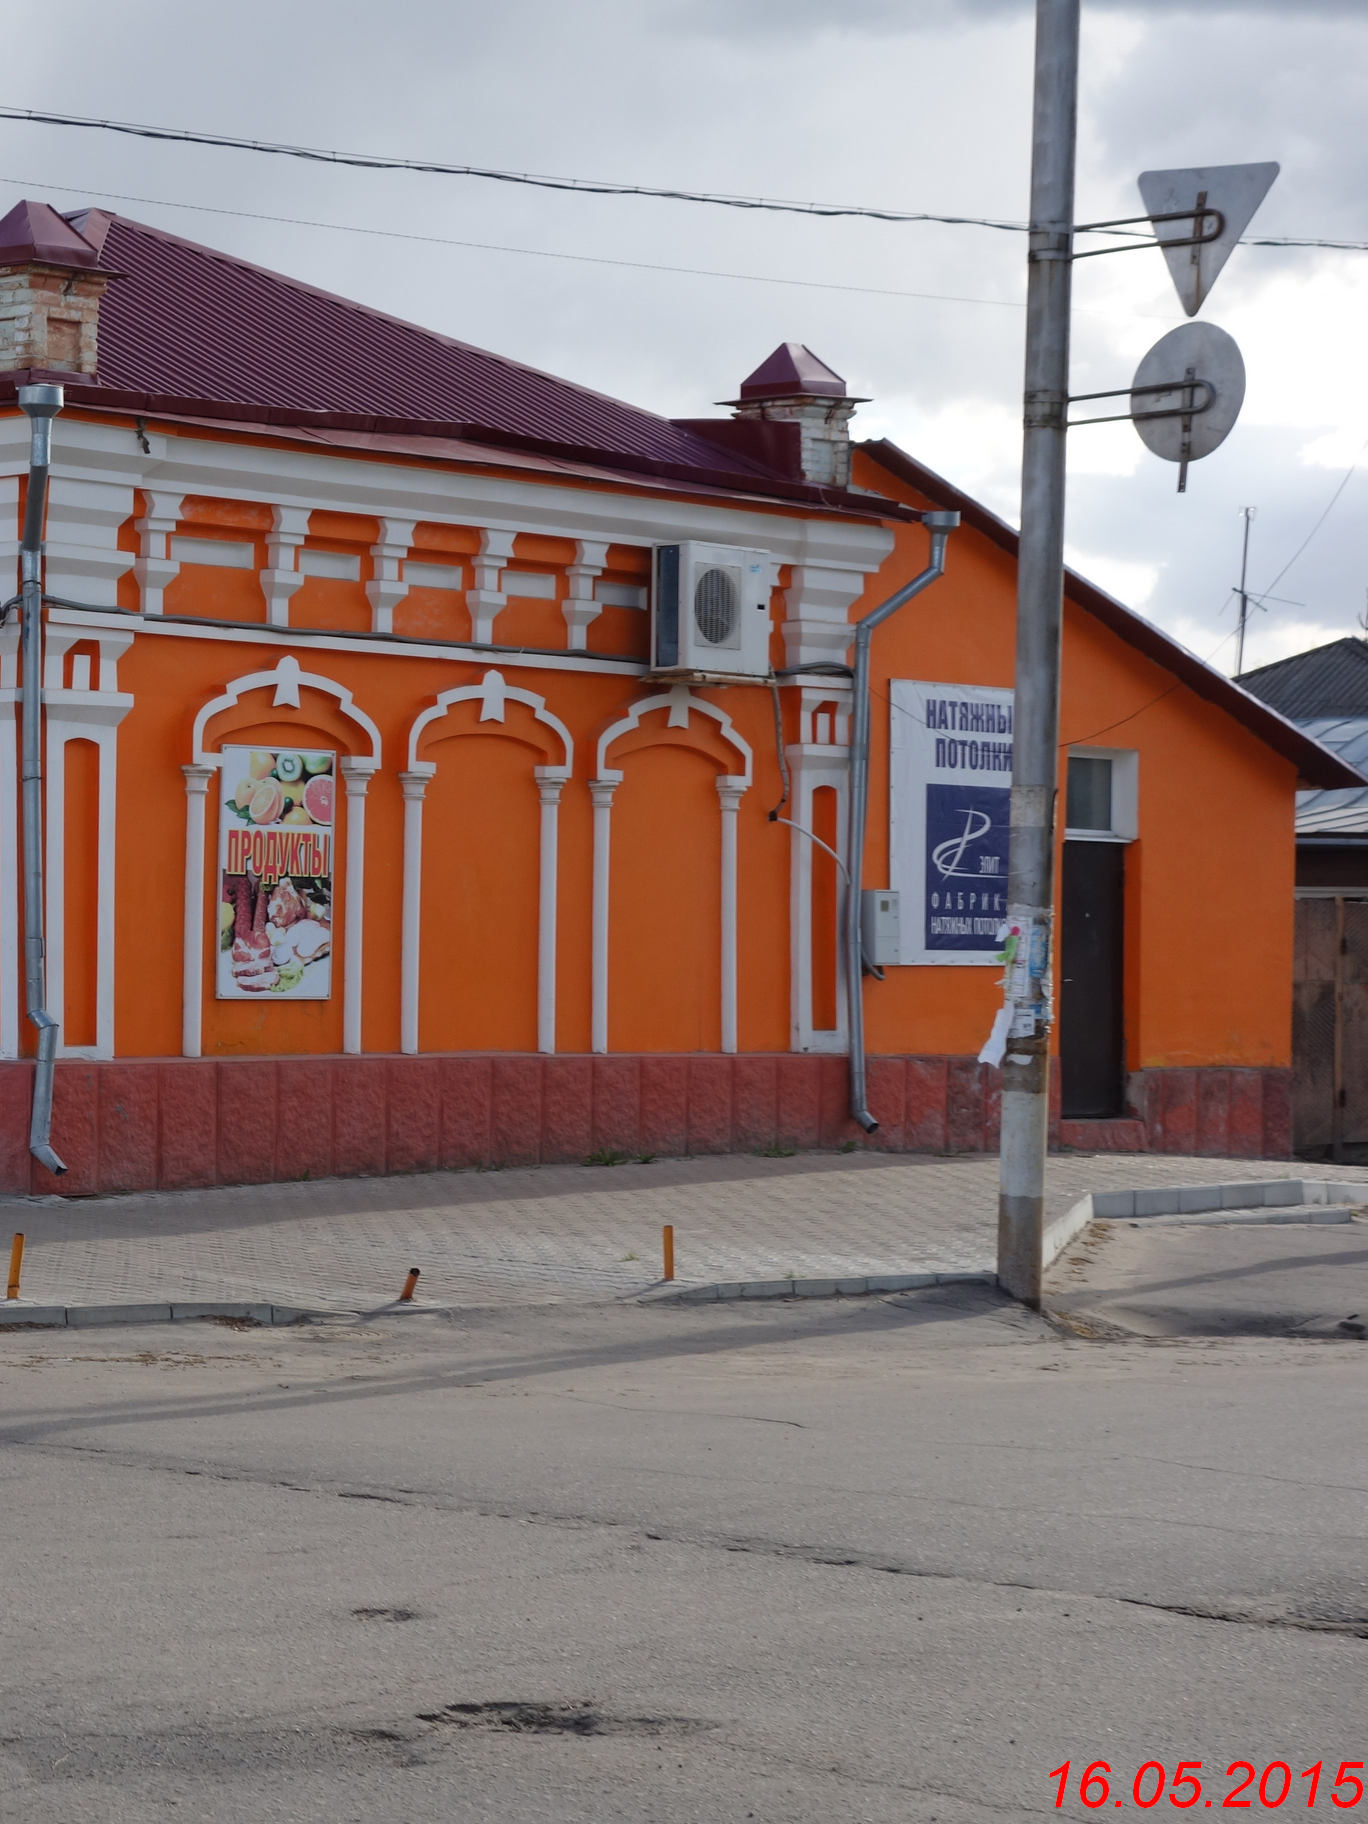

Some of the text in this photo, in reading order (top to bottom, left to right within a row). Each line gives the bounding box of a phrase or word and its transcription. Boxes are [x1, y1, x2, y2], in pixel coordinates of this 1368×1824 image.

[926, 699, 1012, 735] НАТЯЖНЫ
[226, 829, 329, 885] ПРОДУКТЫ
[931, 892, 1008, 911] ФАБРИК
